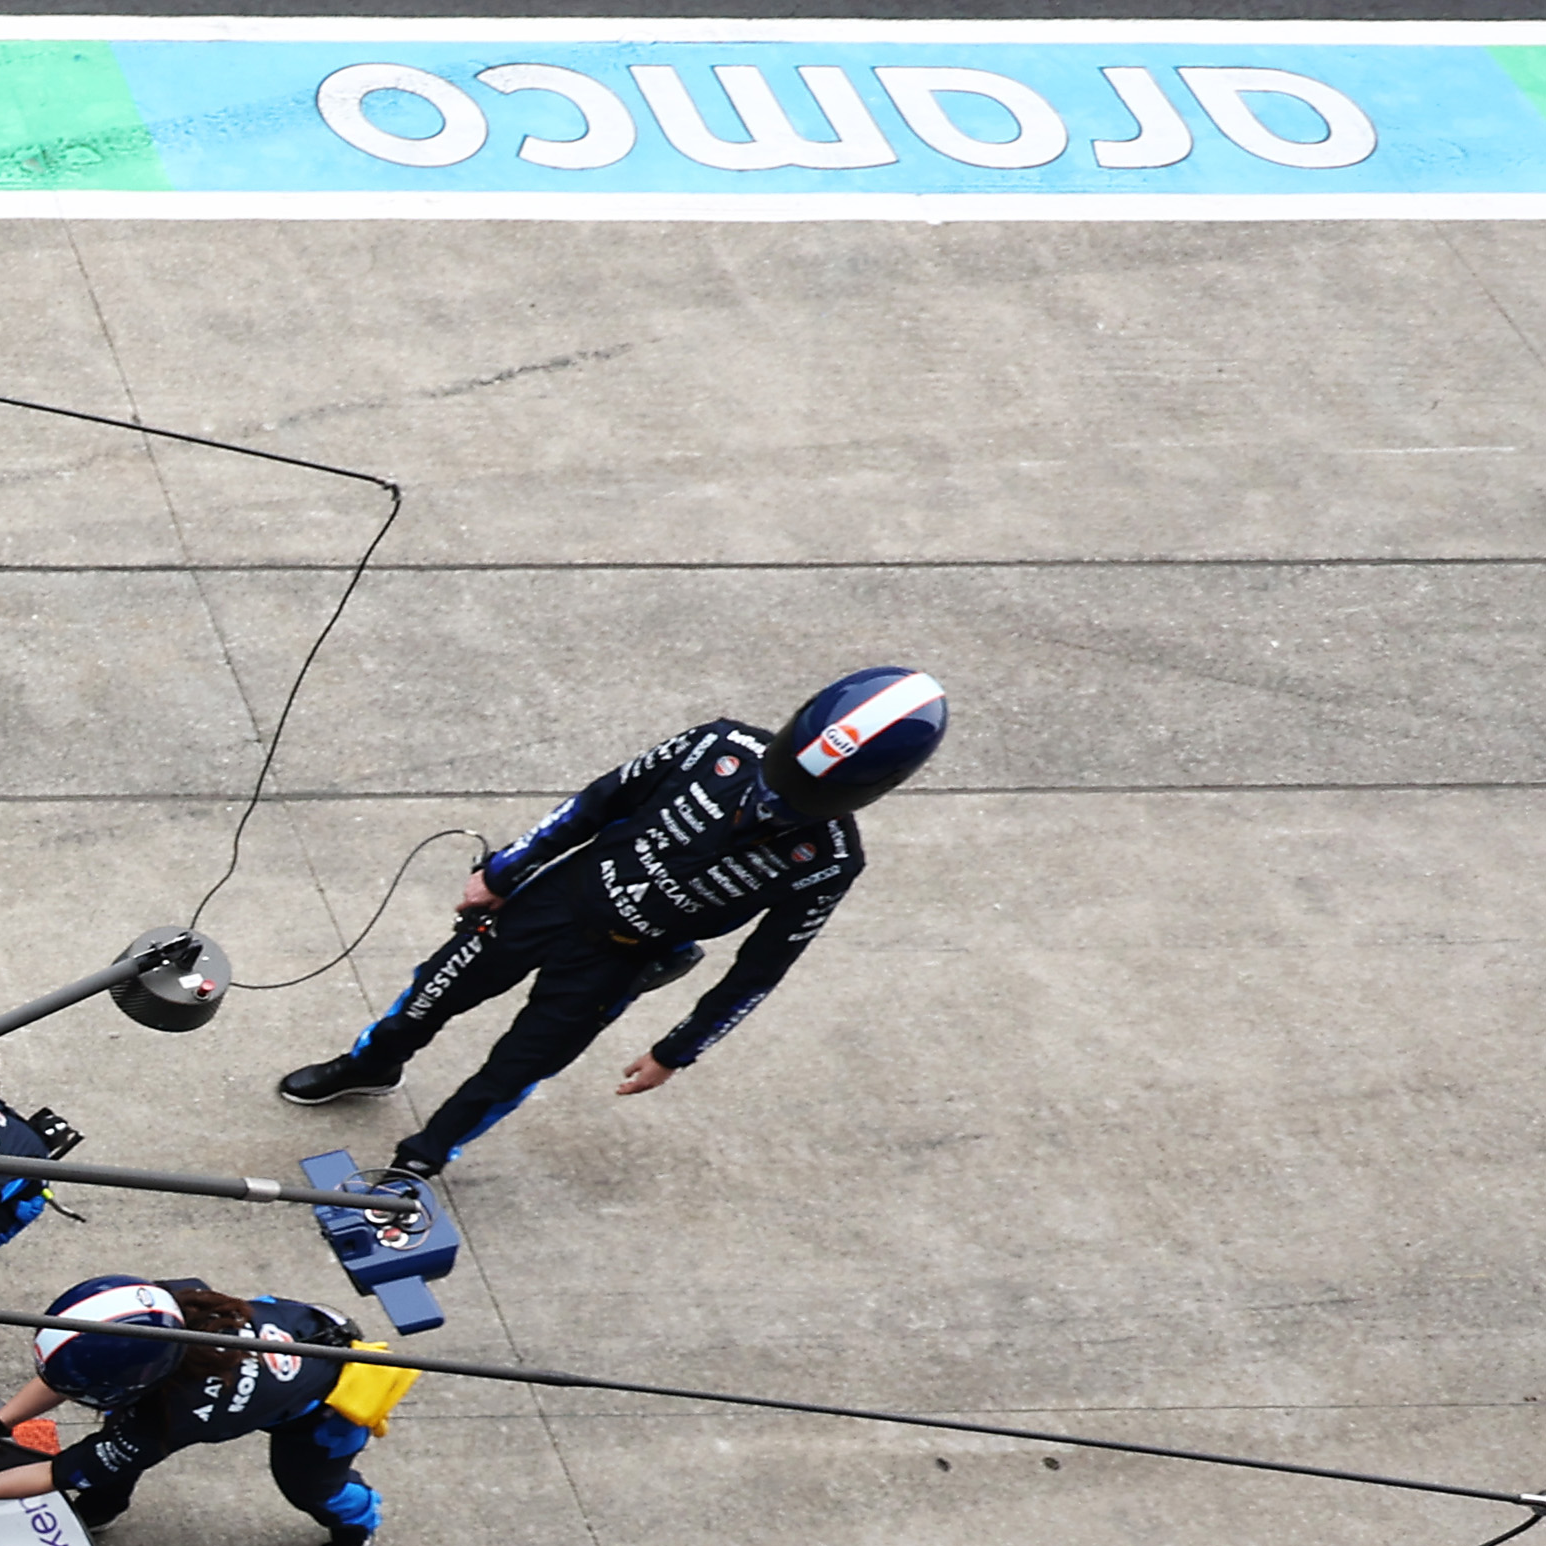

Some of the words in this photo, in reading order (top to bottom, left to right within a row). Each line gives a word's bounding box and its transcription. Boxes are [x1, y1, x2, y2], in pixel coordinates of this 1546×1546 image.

[316, 63, 1379, 170] aramco
[822, 723, 859, 757] Gulf
[599, 859, 666, 938] ATLASSIAN
[638, 852, 705, 915] BARCLAYS
[408, 936, 484, 1020] ATLASSIAN
